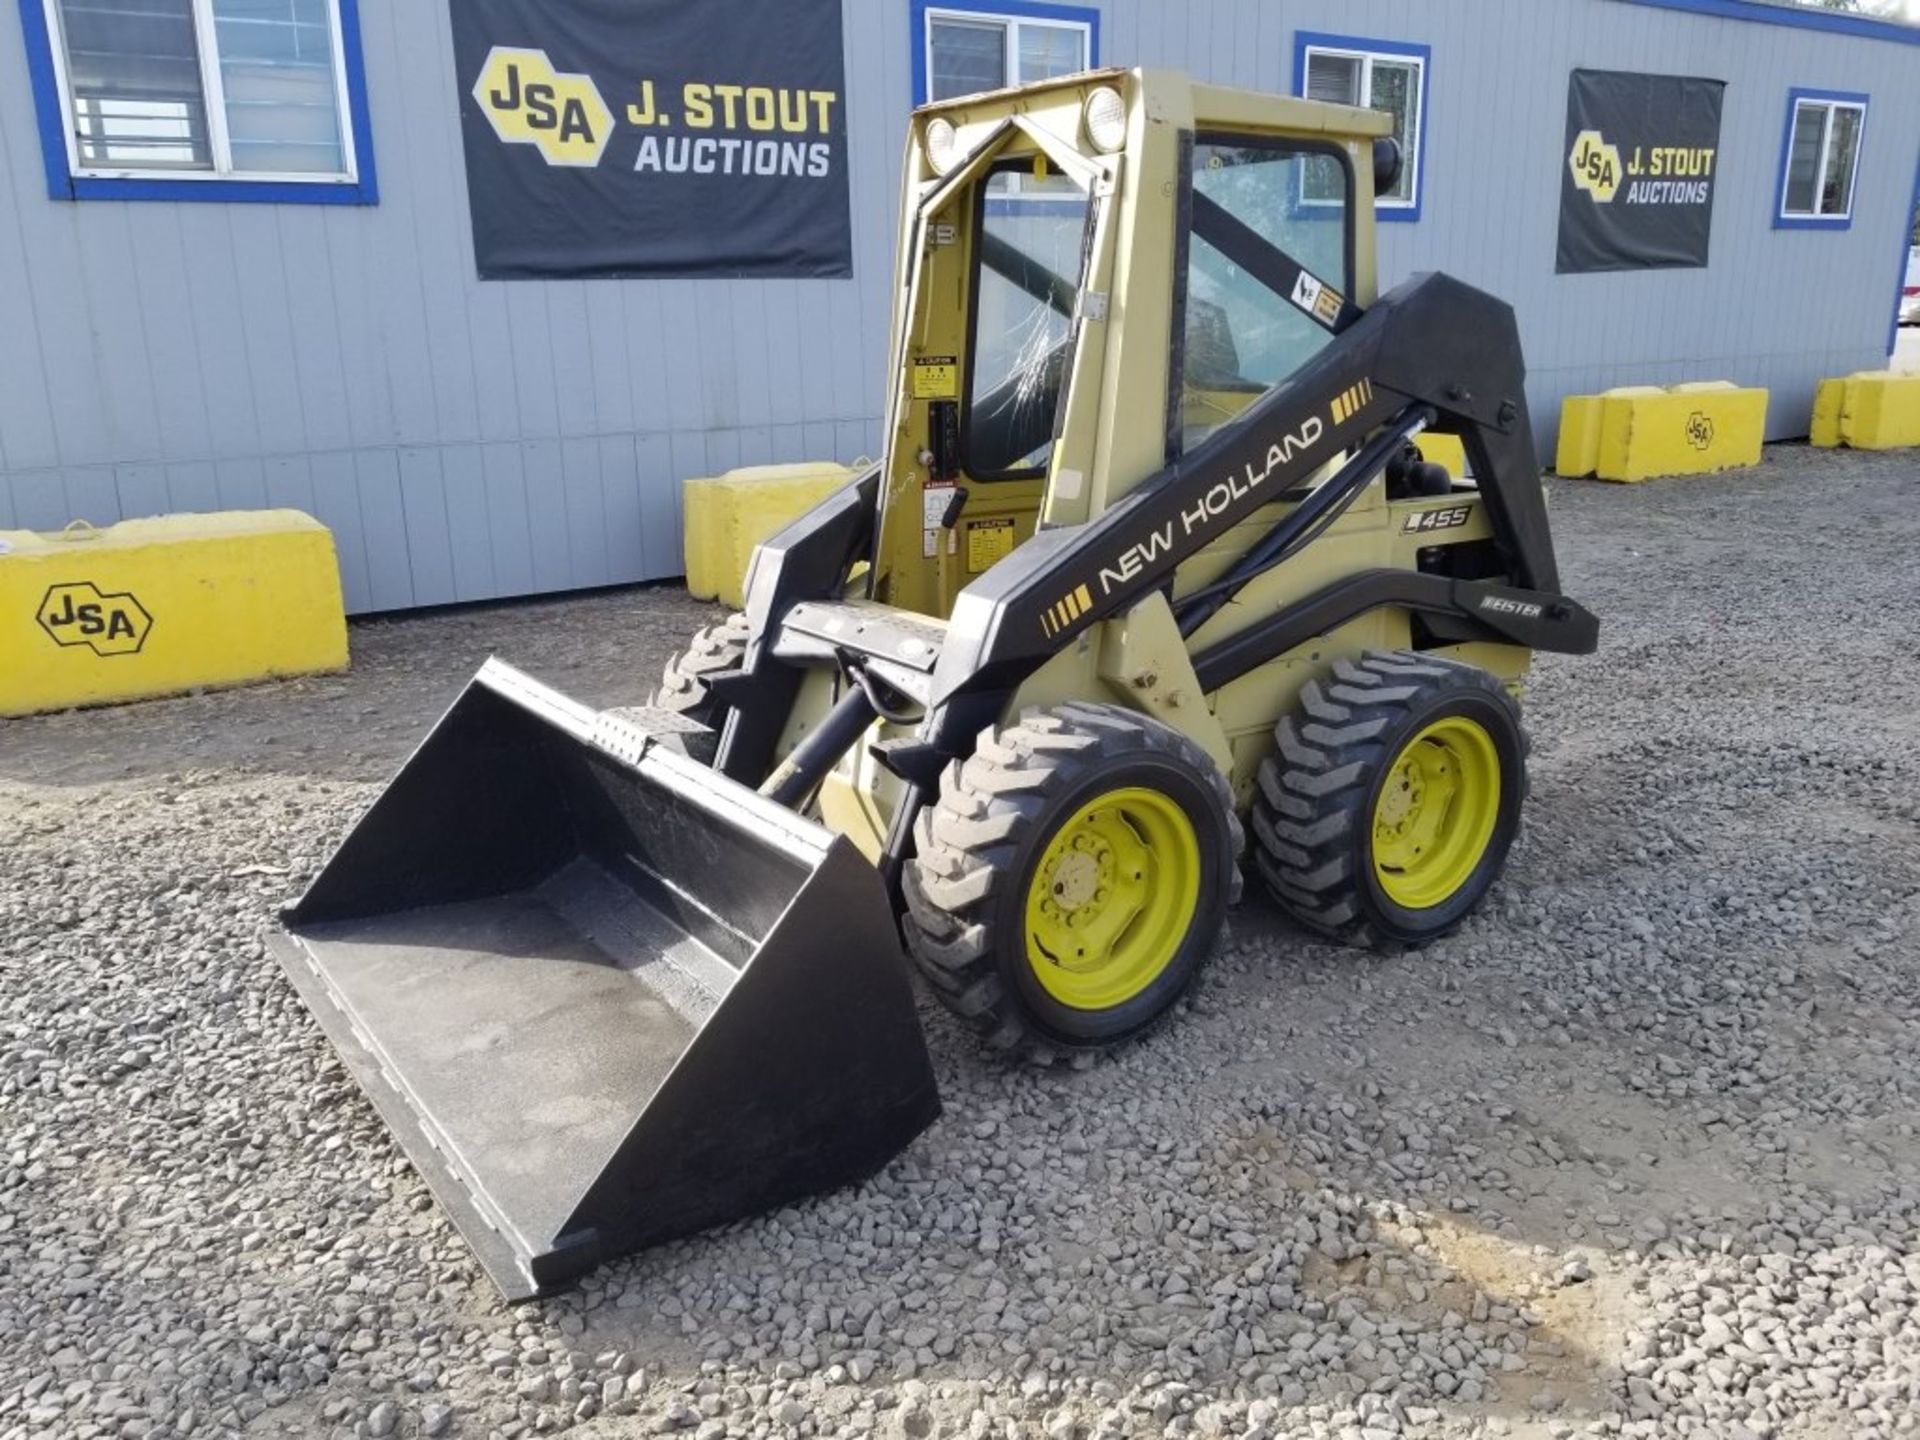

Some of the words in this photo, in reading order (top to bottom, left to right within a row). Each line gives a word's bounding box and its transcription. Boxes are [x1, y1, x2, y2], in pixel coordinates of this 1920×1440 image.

[490, 64, 595, 143] JSA
[627, 80, 669, 126] J.
[683, 83, 835, 134] STOUT
[634, 136, 830, 177] AUCTIONS
[1576, 140, 1613, 188] JSA
[1627, 146, 1645, 175] J.
[1650, 147, 1714, 176] STOUT
[1626, 181, 1708, 204] AUCTIONS
[1099, 521, 1172, 594] NEW
[1181, 416, 1323, 535] HOLLAND
[50, 594, 135, 640] JSA
